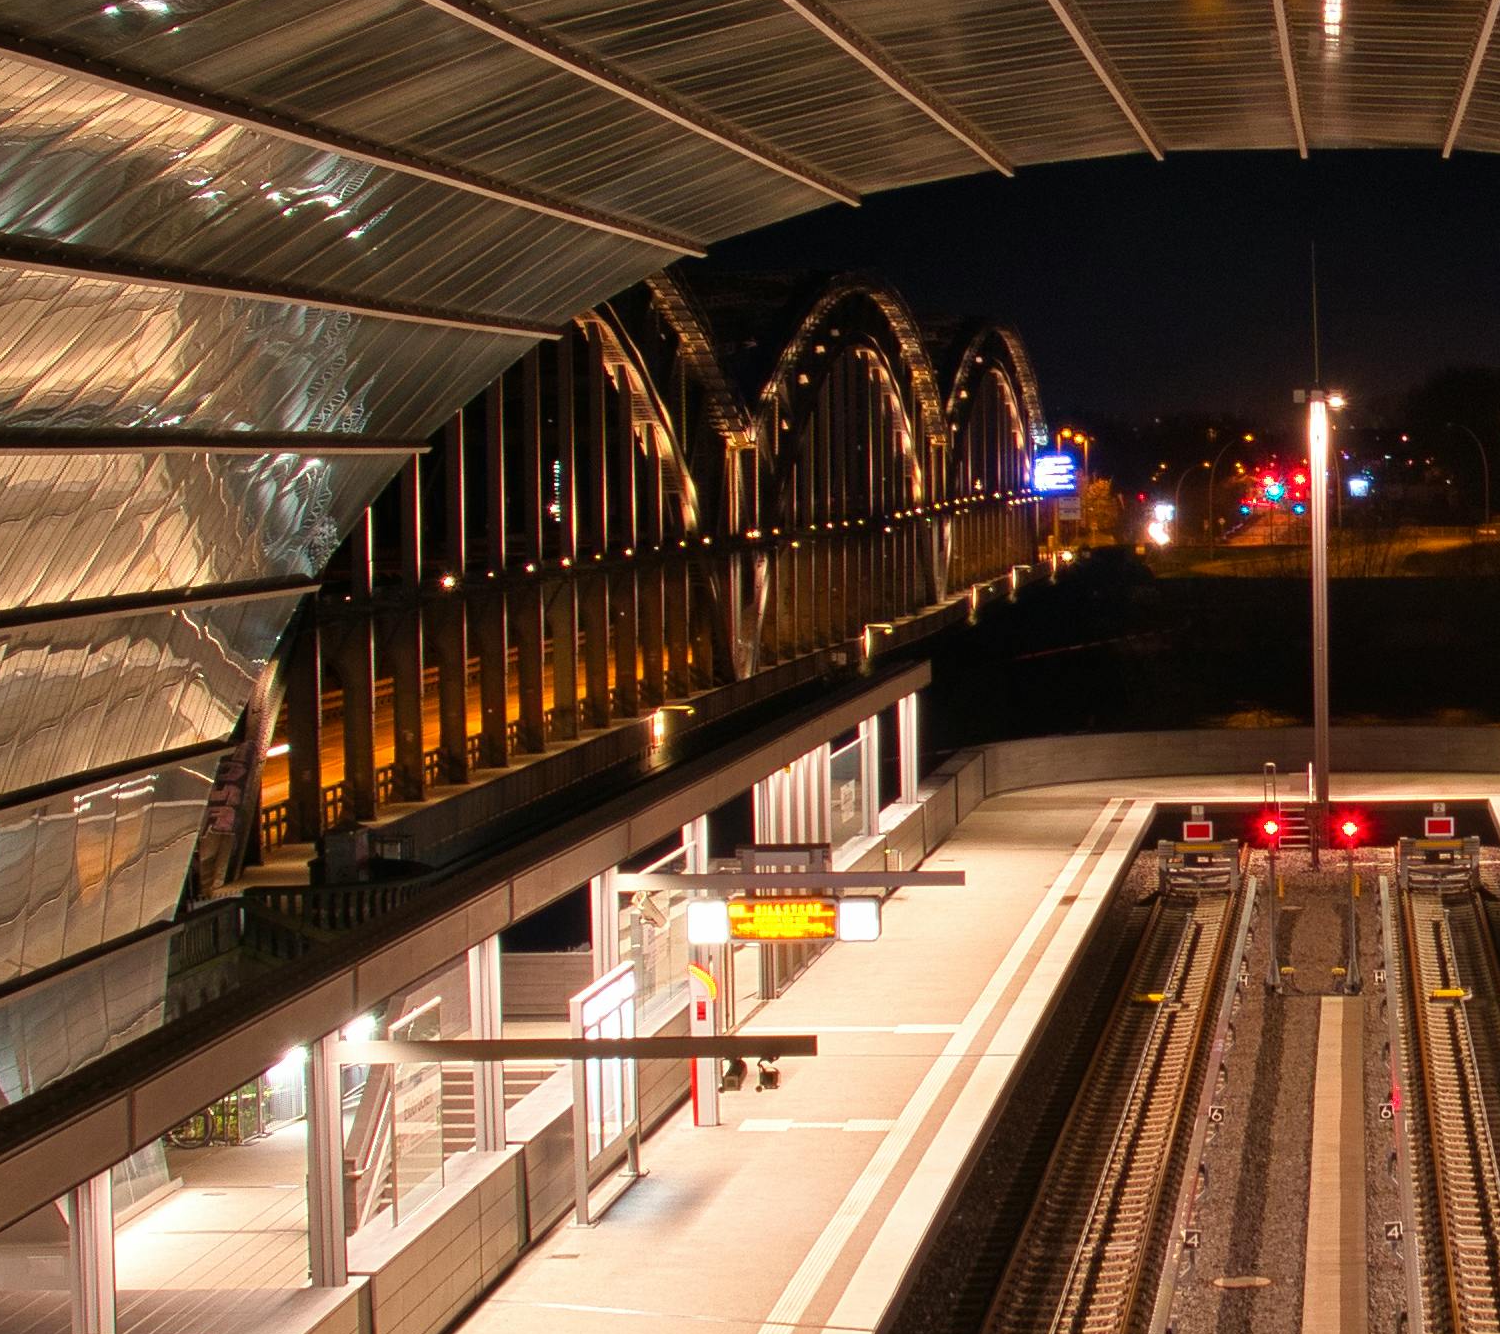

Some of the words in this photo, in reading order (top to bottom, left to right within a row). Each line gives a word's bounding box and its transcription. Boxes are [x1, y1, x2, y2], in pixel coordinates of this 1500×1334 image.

[1212, 1110, 1222, 1121] 6
[1381, 1106, 1391, 1118] 6
[1387, 1226, 1399, 1239] 4
[1187, 1235, 1199, 1247] 4
